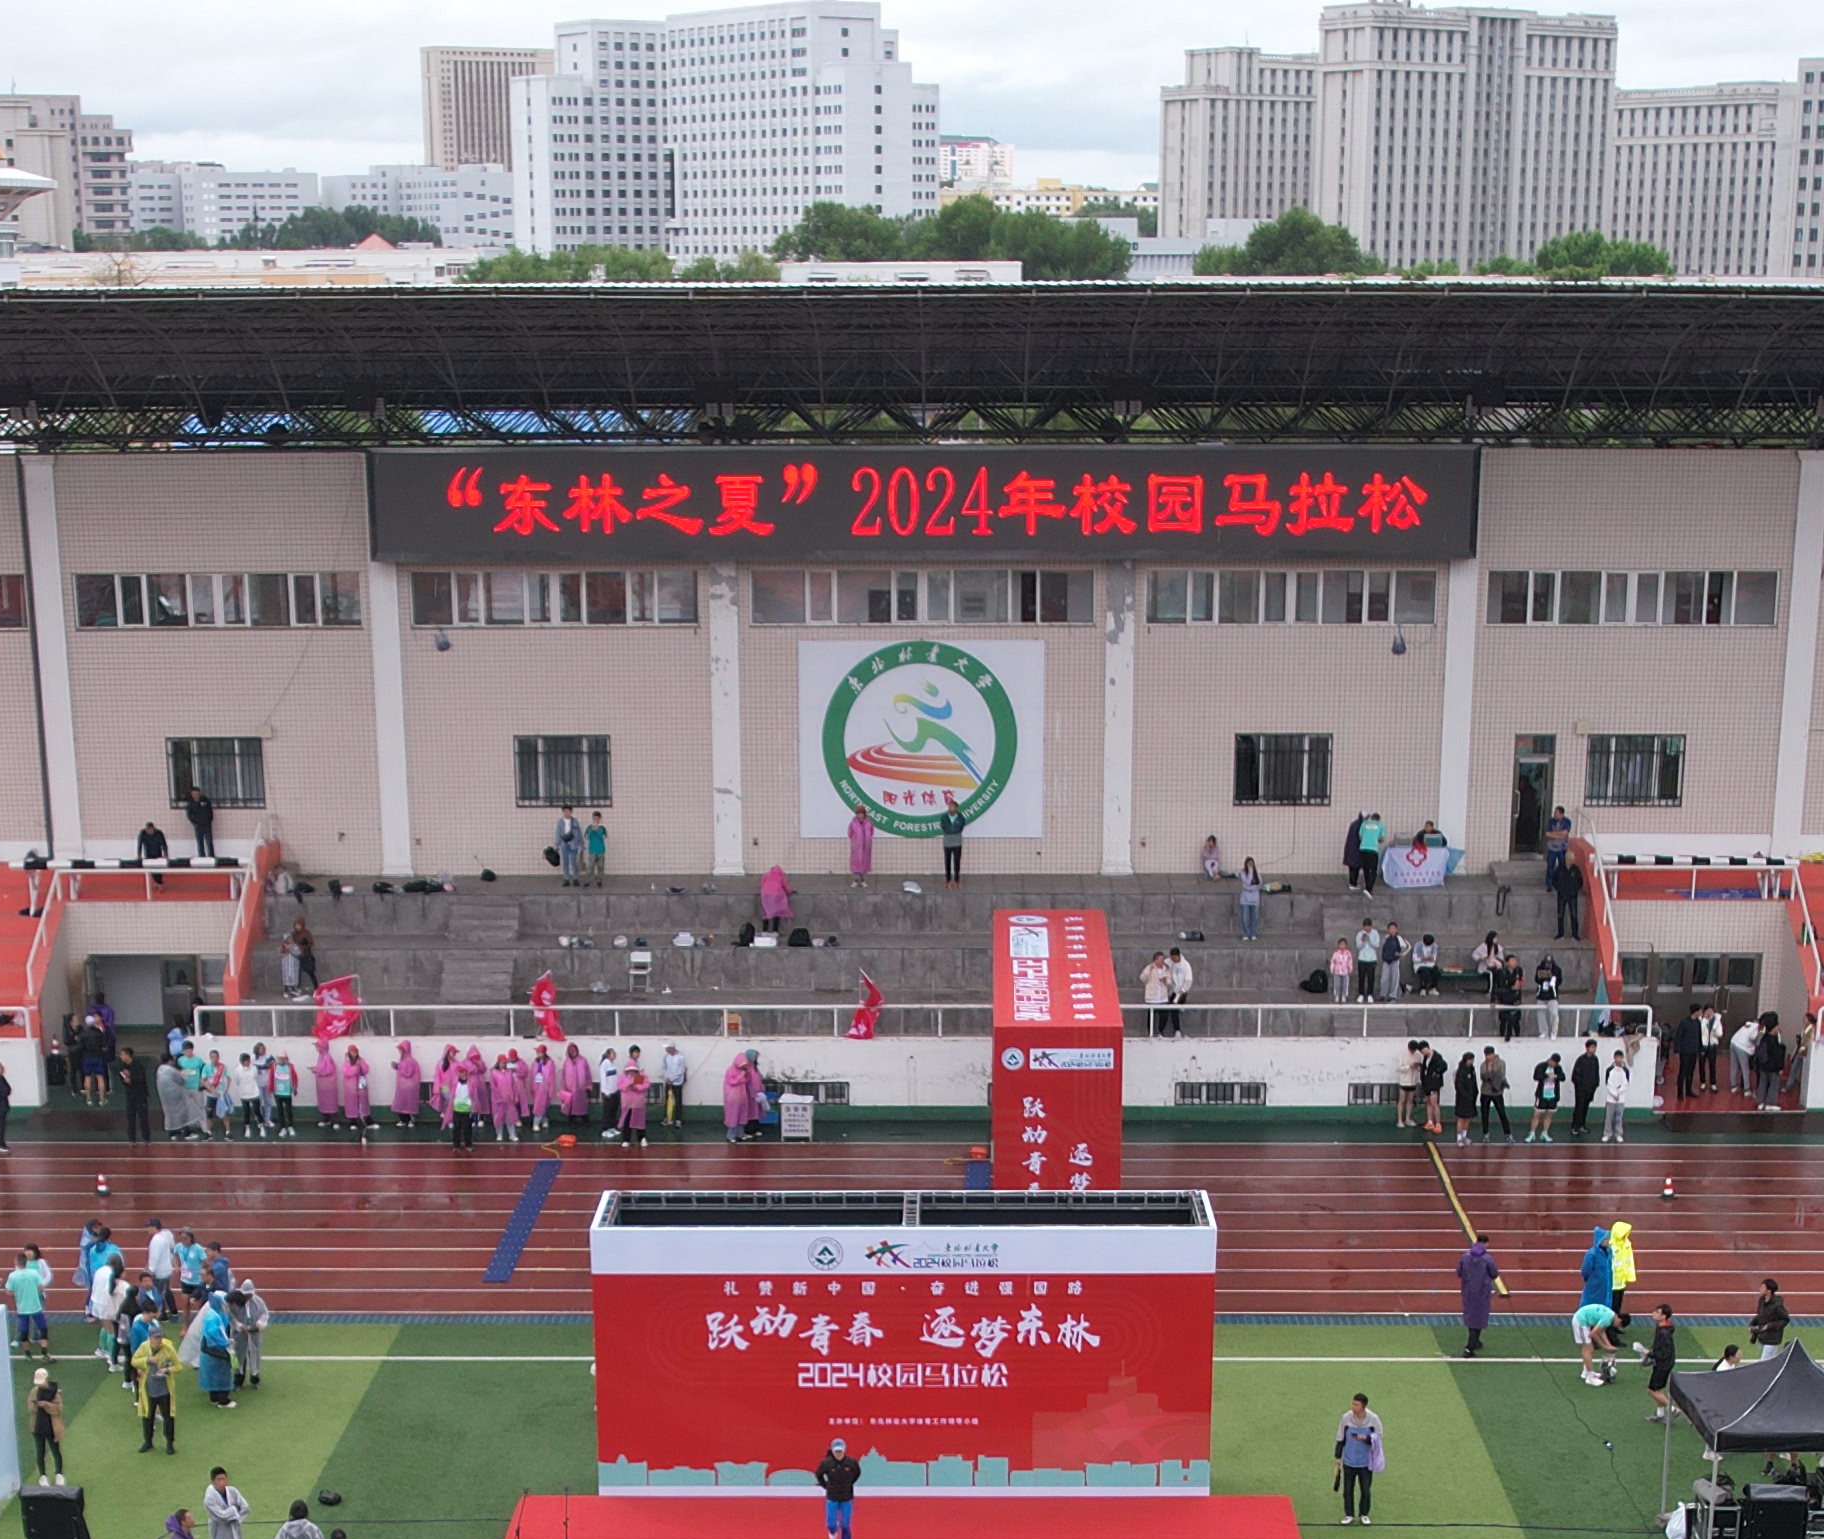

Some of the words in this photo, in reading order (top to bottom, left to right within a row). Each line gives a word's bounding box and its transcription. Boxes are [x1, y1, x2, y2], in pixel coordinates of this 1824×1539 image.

[446, 462, 819, 537] “东林之夏”
[850, 465, 1428, 537] 2024年校园马拉松
[882, 789, 956, 806] 阳光体育
[723, 1280, 1083, 1297] 礼赞新中国·奋进强国路
[705, 1303, 885, 1357] 跃动青春
[919, 1303, 1102, 1358] 逐梦东林
[797, 1362, 1009, 1389] 2024校园马拉松
